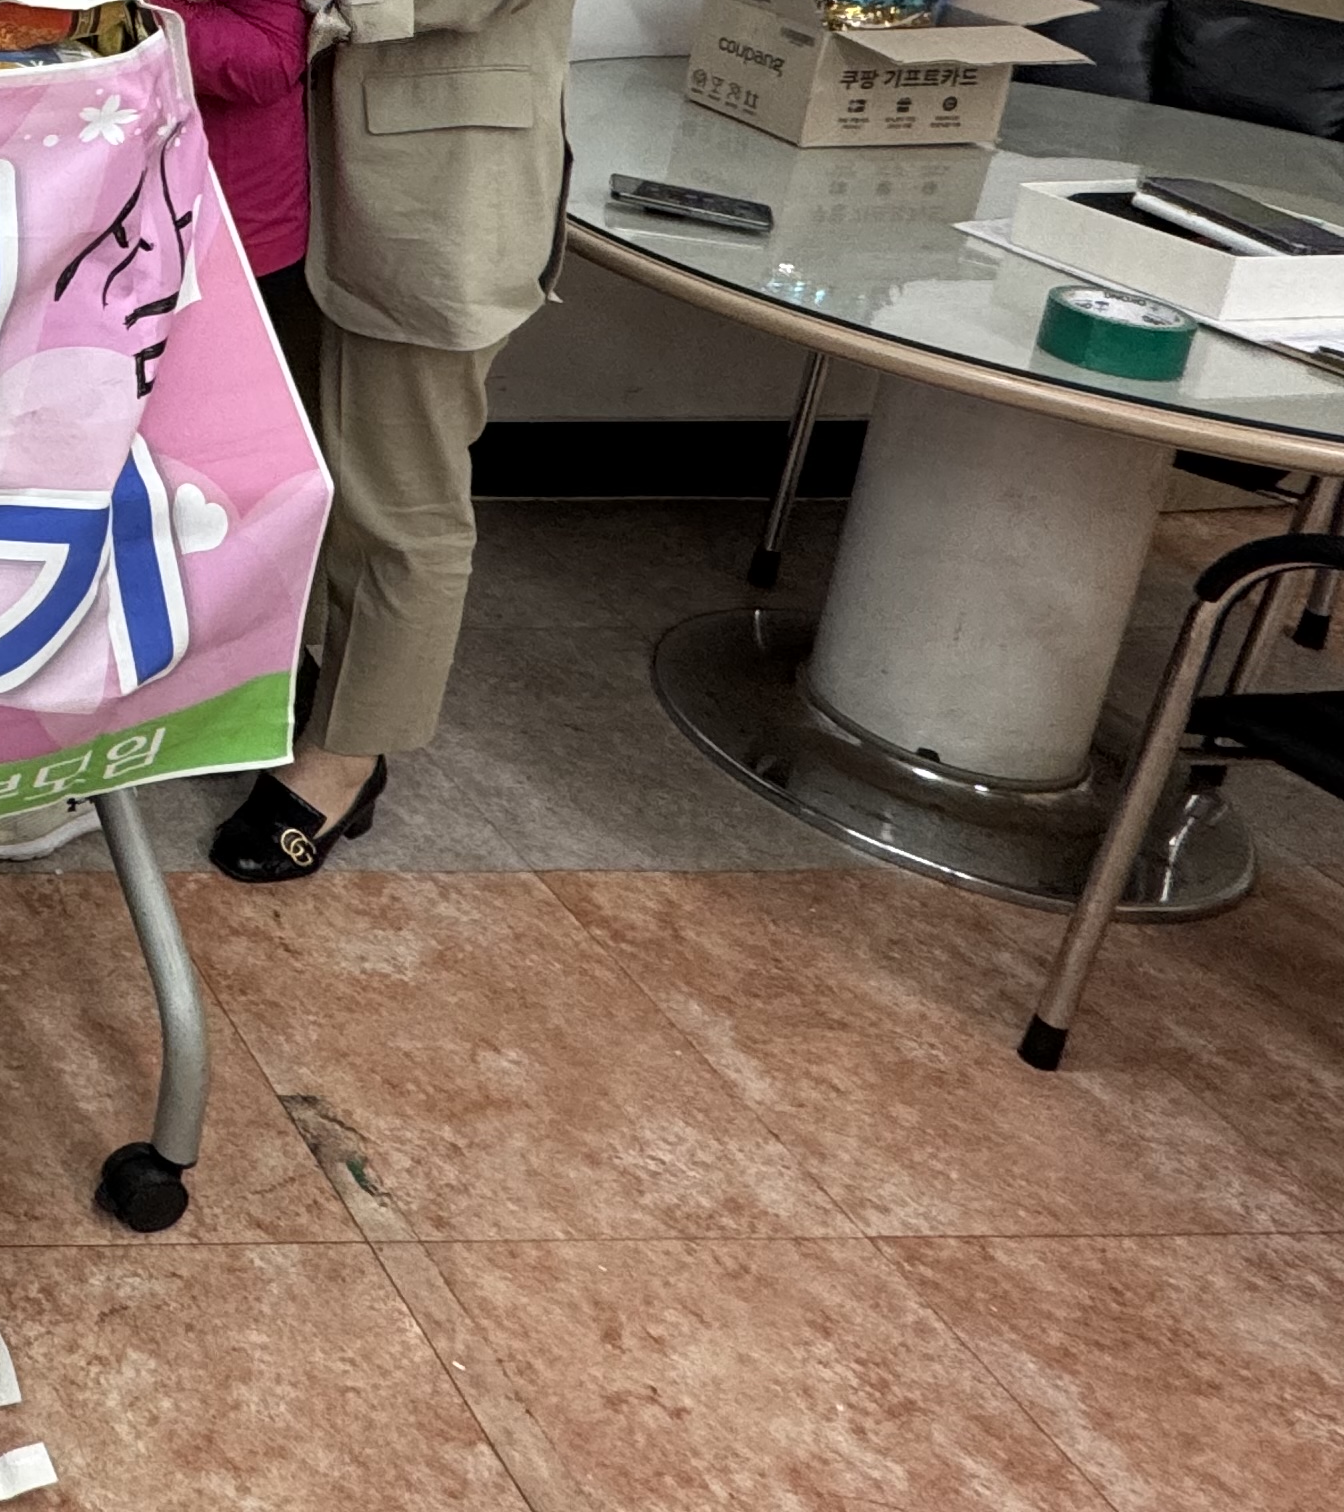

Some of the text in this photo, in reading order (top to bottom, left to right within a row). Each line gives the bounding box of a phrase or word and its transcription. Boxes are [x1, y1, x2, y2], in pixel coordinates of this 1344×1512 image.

[718, 35, 786, 79] coupang
[840, 67, 979, 91] 쿠팡 기프트카드
